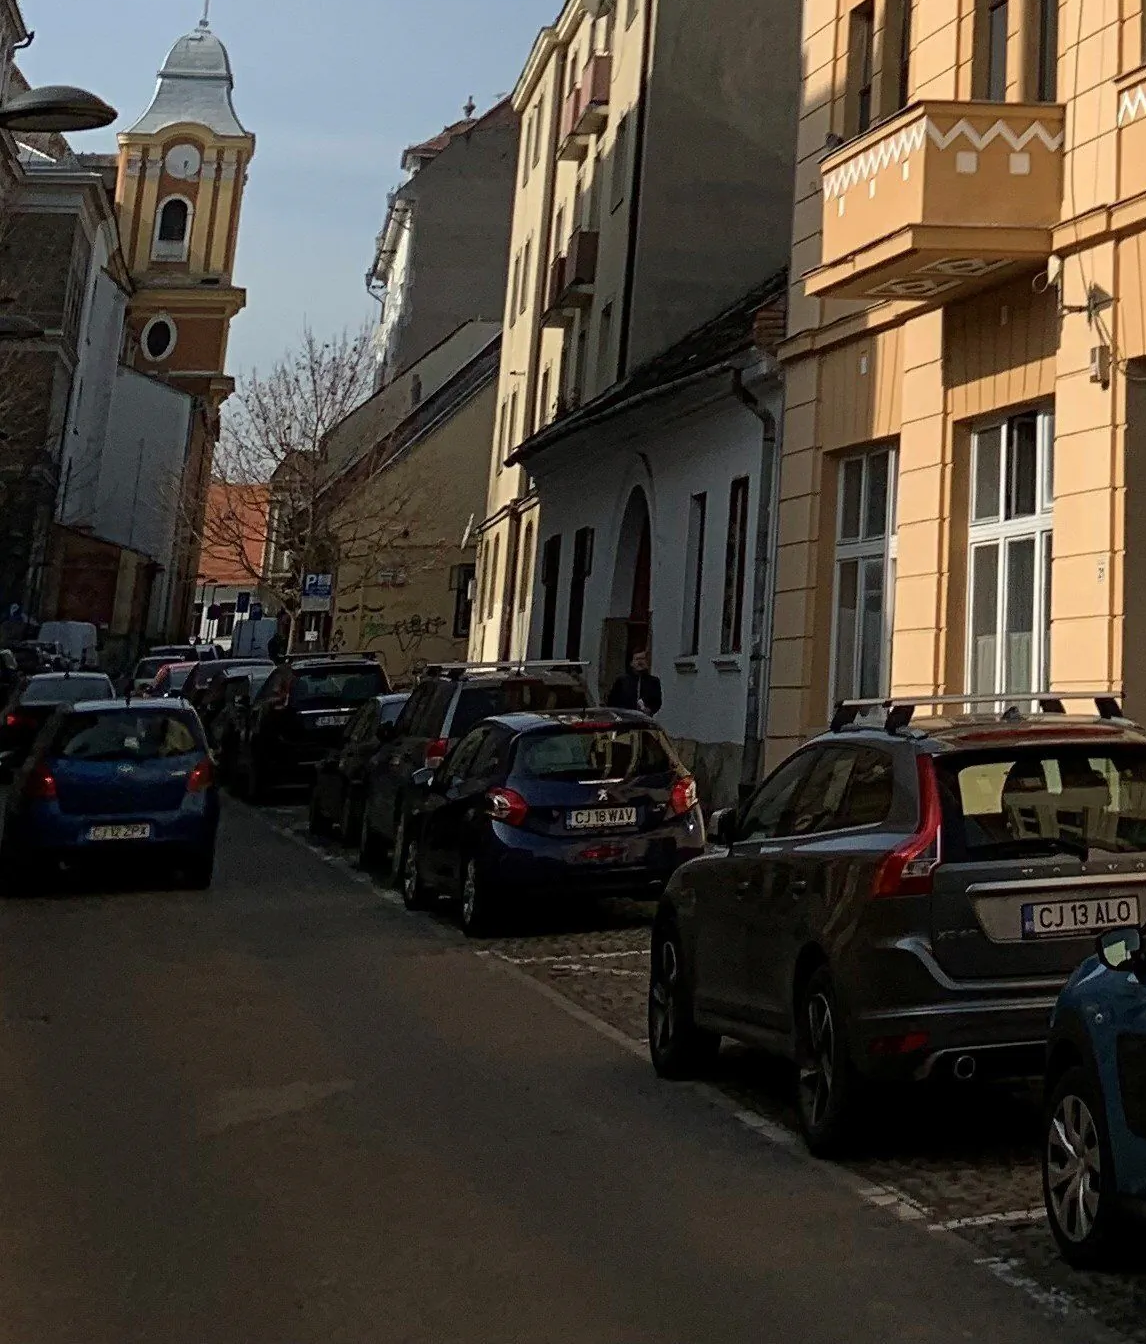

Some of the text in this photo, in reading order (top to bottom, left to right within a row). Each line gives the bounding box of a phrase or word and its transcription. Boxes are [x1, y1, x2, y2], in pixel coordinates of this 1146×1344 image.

[305, 574, 317, 590] P
[575, 809, 633, 824] CJ 18 WAV
[1039, 900, 1131, 928] CJ 13 ALO
